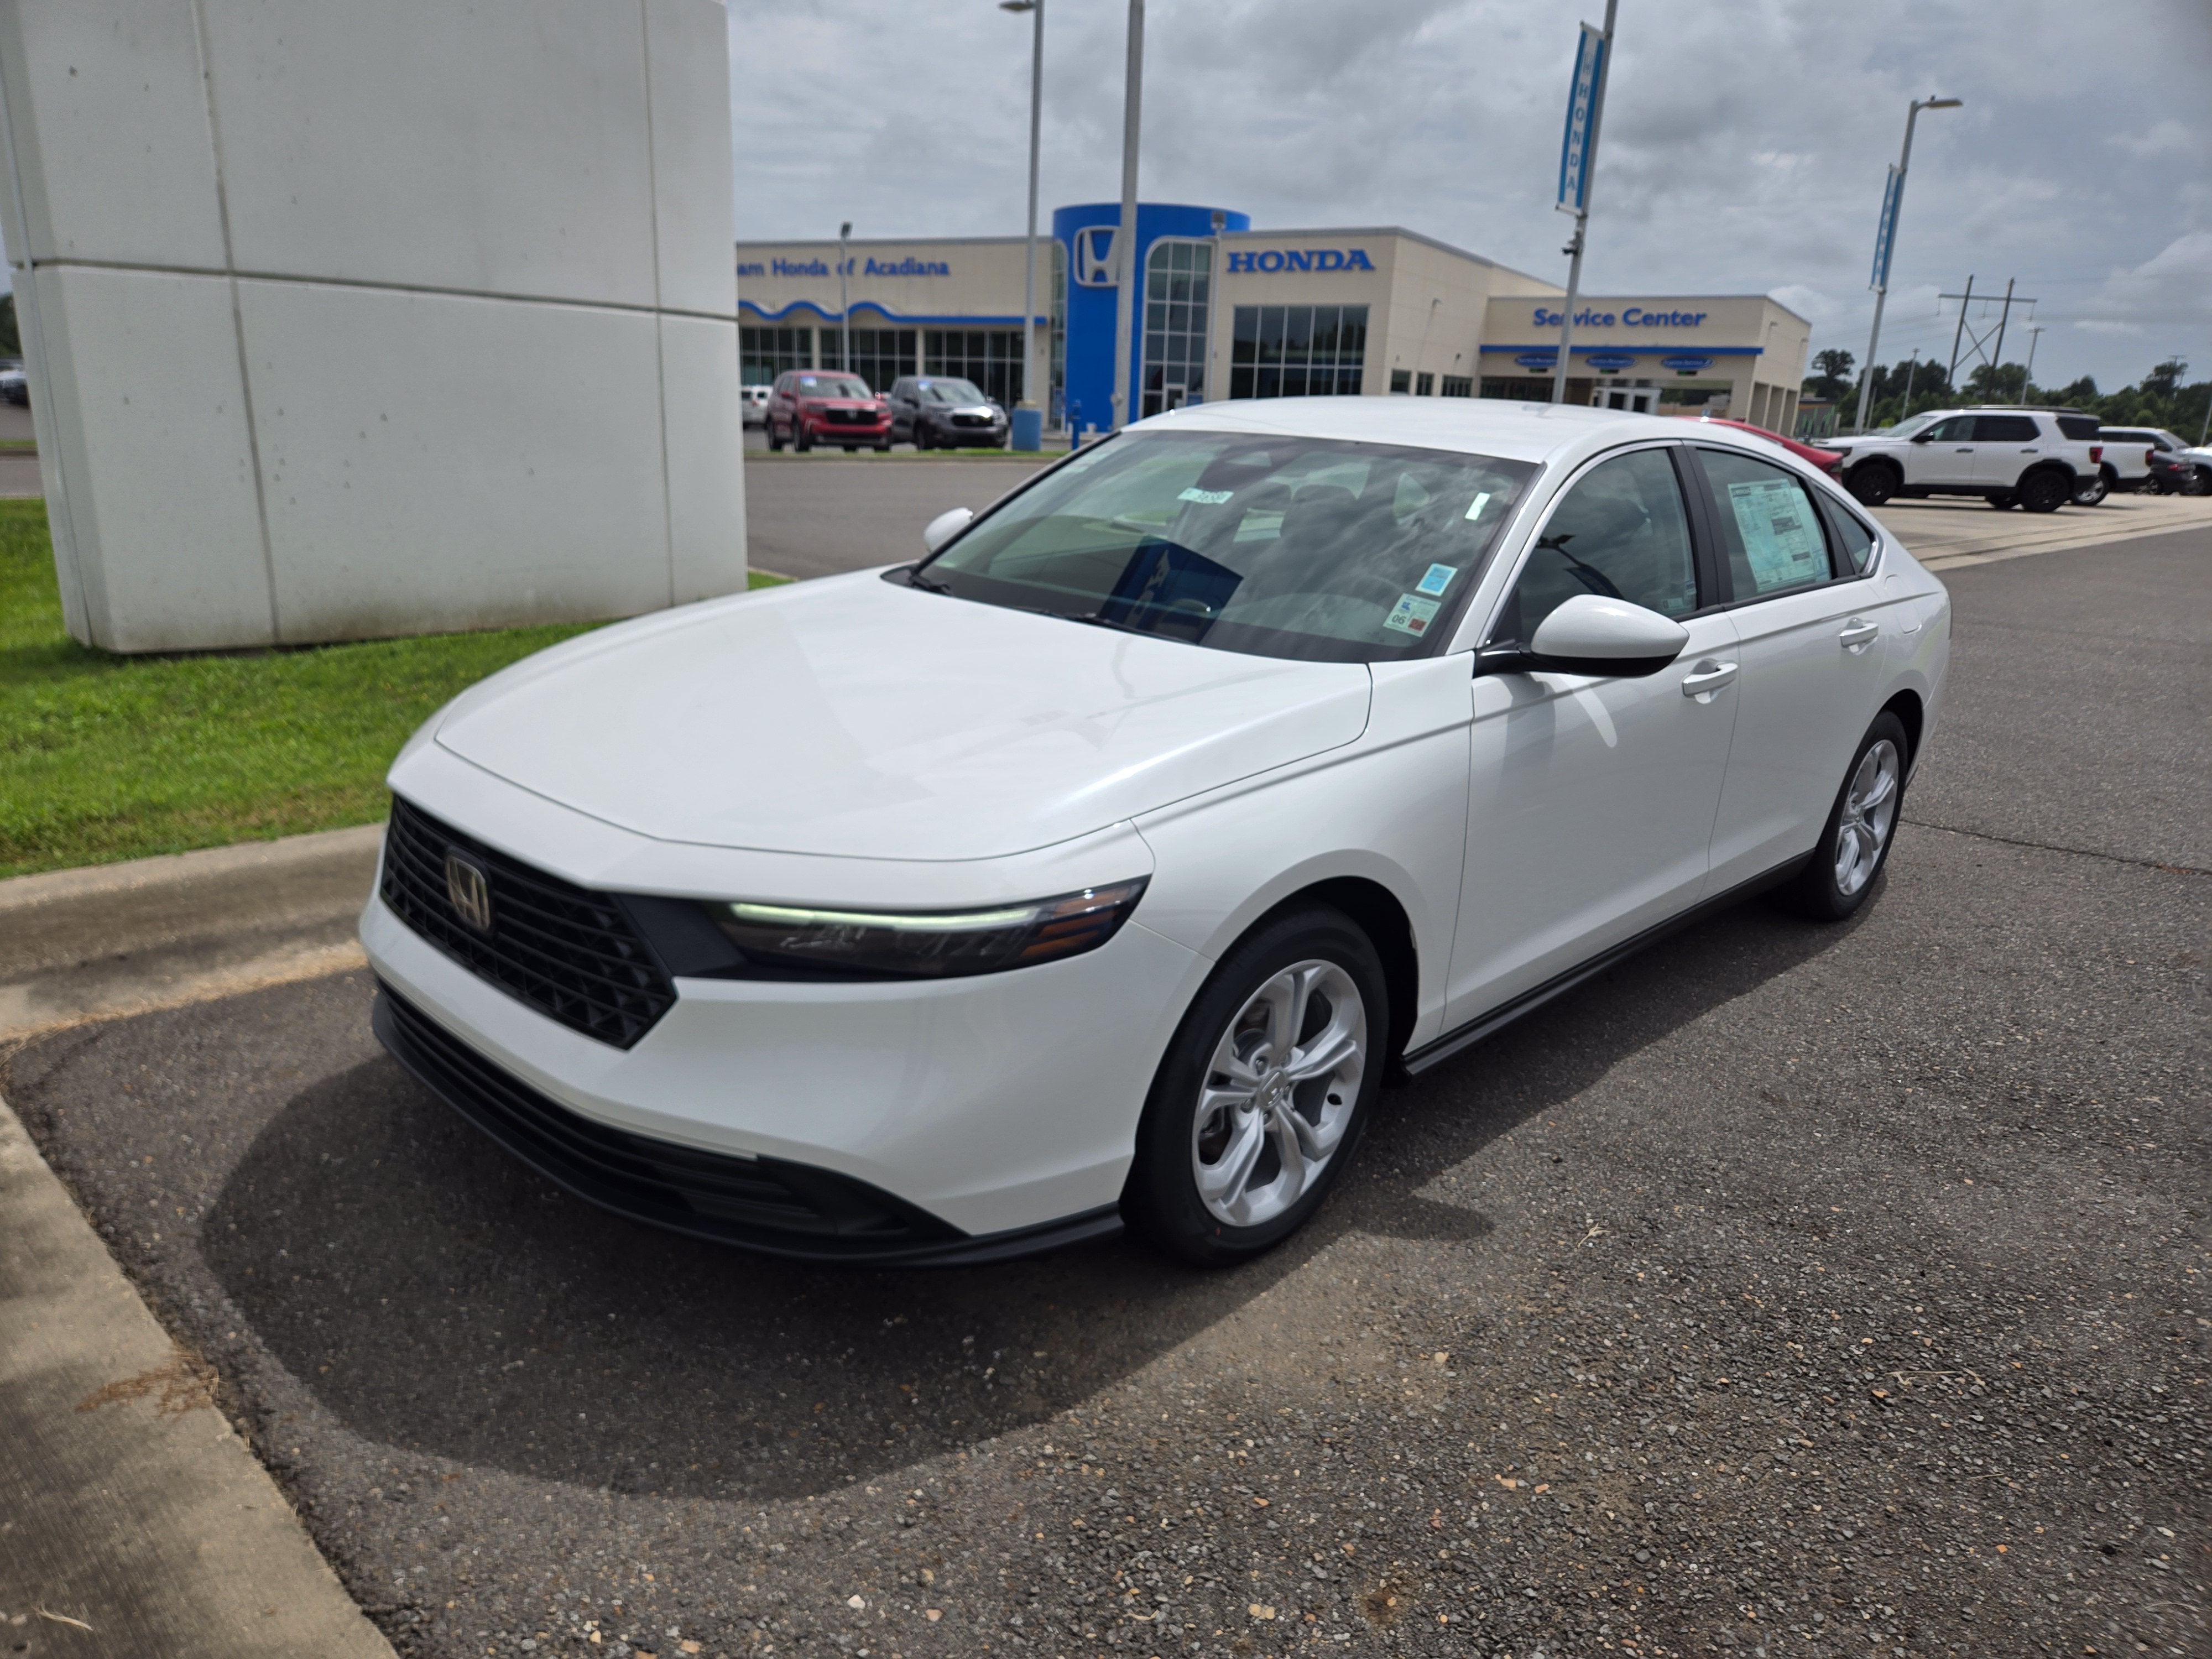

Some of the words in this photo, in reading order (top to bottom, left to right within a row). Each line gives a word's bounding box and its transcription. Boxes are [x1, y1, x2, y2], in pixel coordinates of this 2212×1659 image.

[737, 263, 764, 275] am
[772, 257, 829, 275] Honda
[864, 257, 951, 275] Acadiana
[1227, 248, 1376, 273] HONDA
[1623, 307, 1708, 327] Center
[1391, 614, 1407, 625] 06
